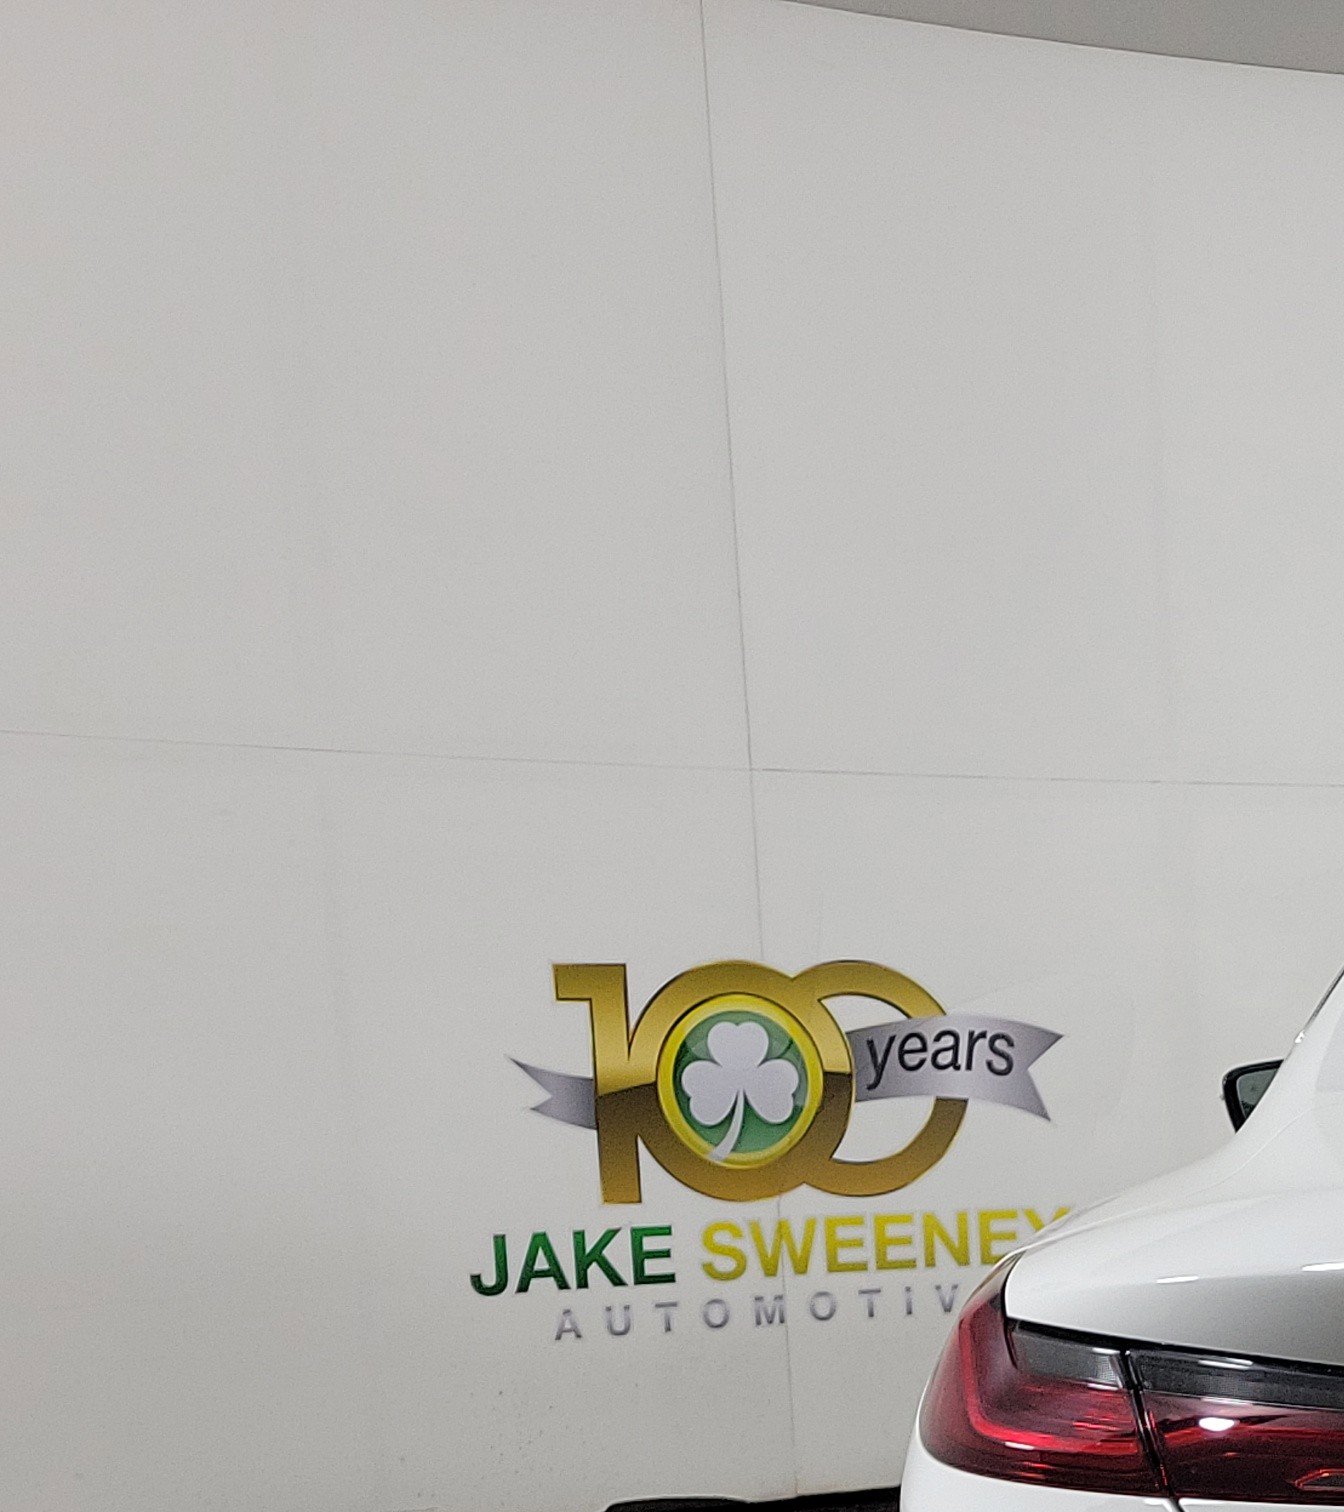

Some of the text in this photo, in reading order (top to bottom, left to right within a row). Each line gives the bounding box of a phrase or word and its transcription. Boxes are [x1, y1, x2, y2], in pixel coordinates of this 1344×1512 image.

[552, 959, 1016, 1204] 100 years
[469, 1224, 677, 1298] JAKE
[554, 1283, 959, 1342] AUTOMOTIV
